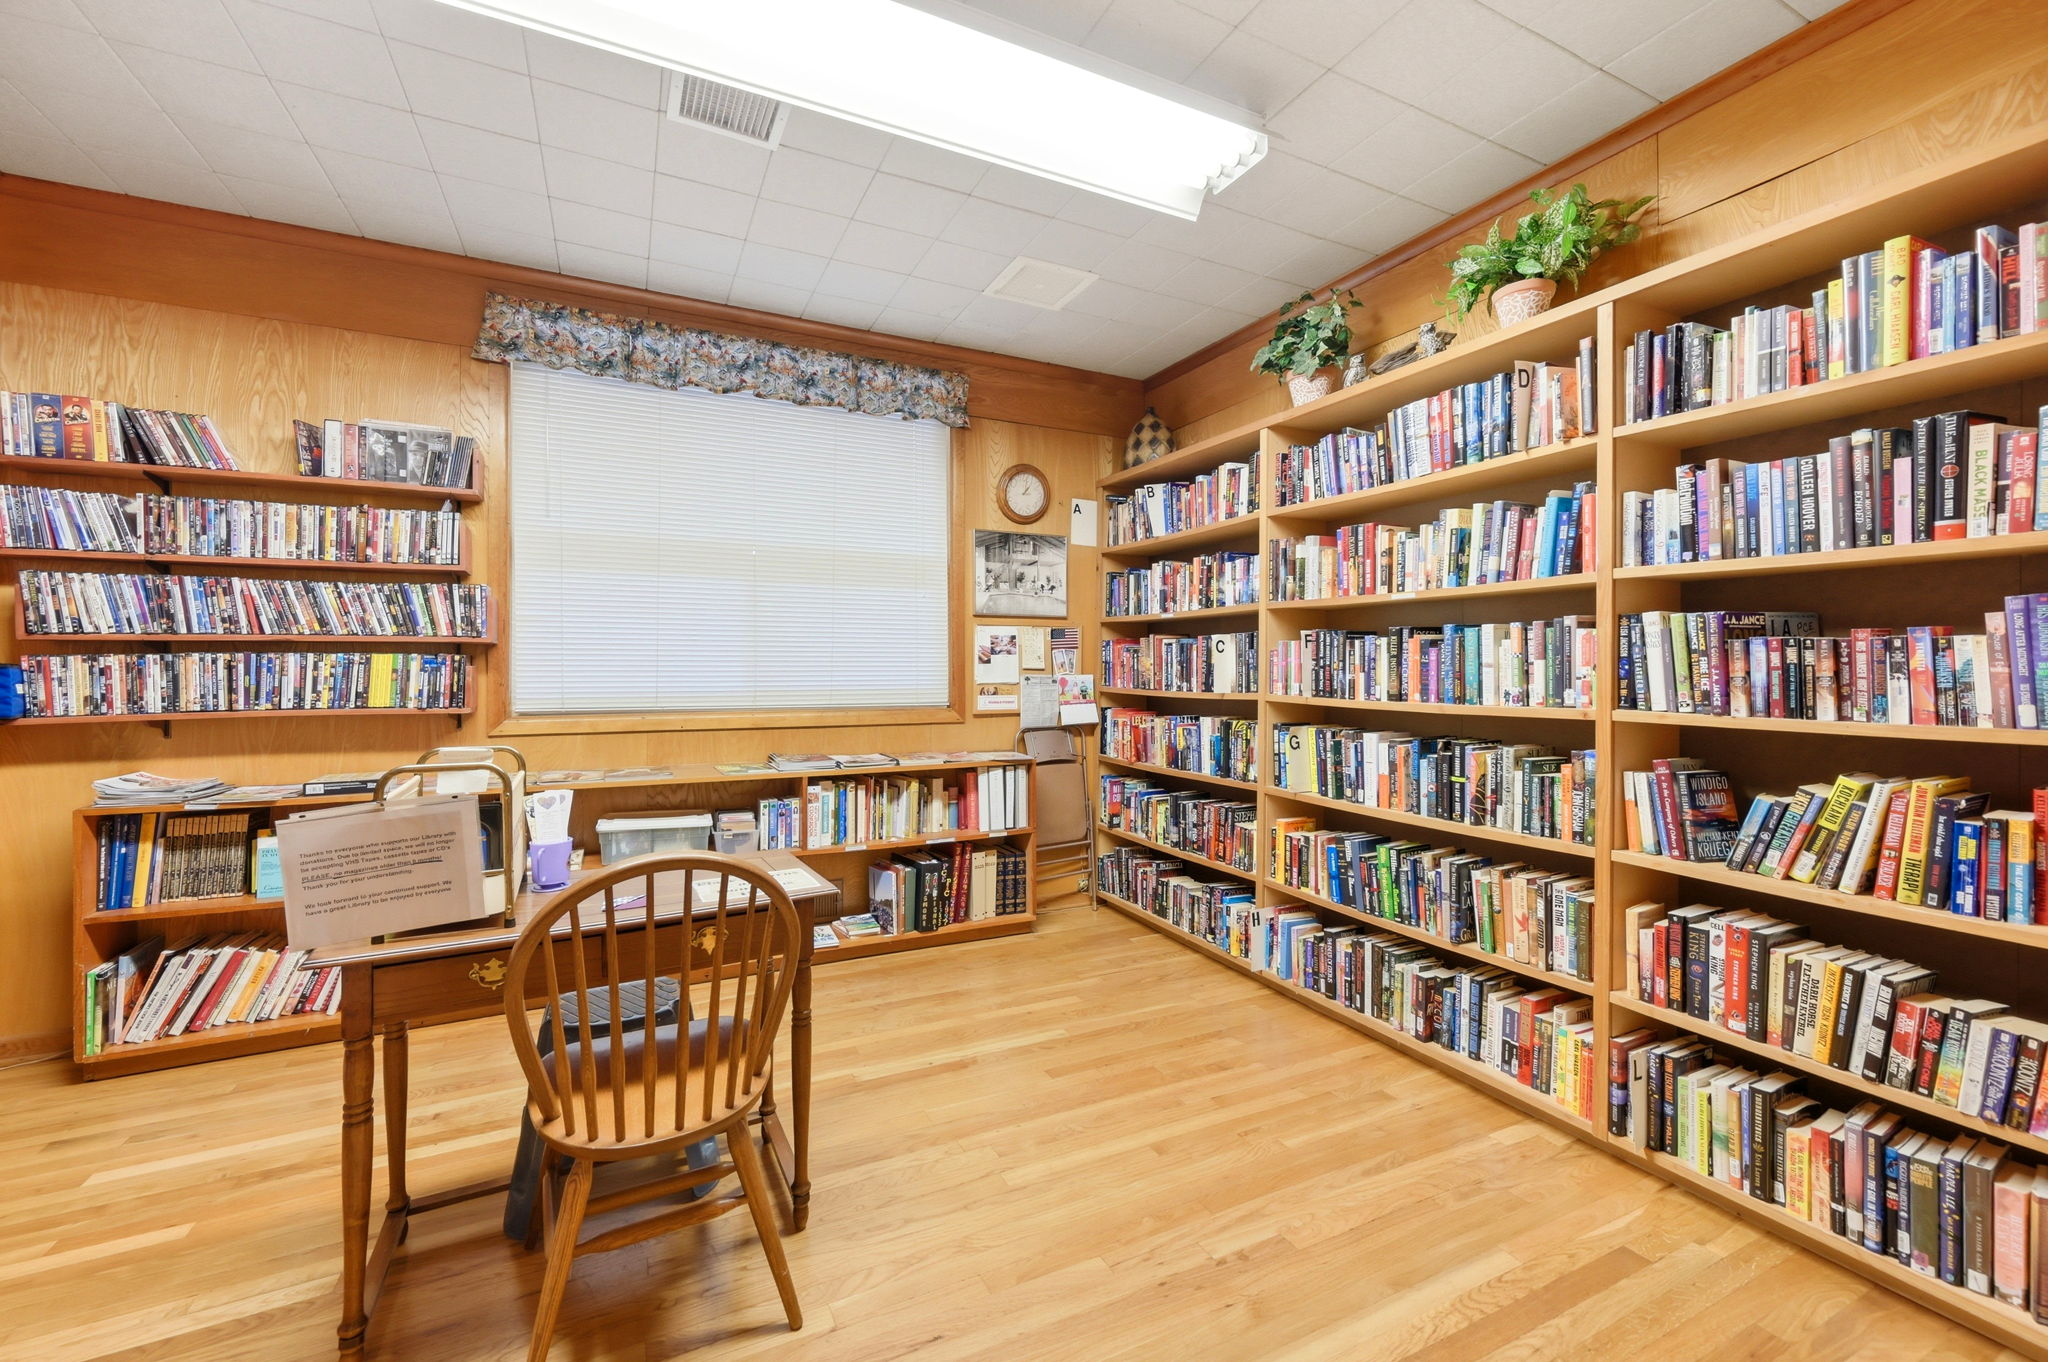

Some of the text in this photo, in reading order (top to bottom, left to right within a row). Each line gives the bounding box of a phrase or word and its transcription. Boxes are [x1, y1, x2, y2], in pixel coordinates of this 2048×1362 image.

[2003, 256, 2020, 284] HILL
[1890, 290, 1902, 350] CARL HIAASEN
[1518, 368, 1530, 388] D
[1944, 415, 1957, 464] TIME HUNT
[1974, 450, 1988, 485] BLACK
[2024, 451, 2034, 478] LOSING
[1148, 486, 1155, 498] B
[1679, 477, 1694, 526] Retribution
[1801, 458, 1814, 530] COLLEEN HOOVER
[1074, 504, 1082, 514] A
[1855, 490, 1863, 524] ECHOED
[1724, 613, 1766, 624] J.A. JANCE
[1216, 640, 1225, 654] C
[1305, 634, 1312, 648] F
[1620, 626, 1630, 657] LISA JACKSON
[1698, 630, 1706, 650] JANCE
[2014, 613, 2028, 676] LONG AFTER MIDNIGHT
[1700, 656, 1710, 690] FIRE ICE
[1712, 668, 1720, 682] J.A.
[1936, 656, 1952, 688] JOHANSEN
[1290, 735, 1300, 750] G
[1572, 790, 1584, 806] JOHN
[1663, 788, 1671, 797] the
[1690, 776, 1728, 806] WINDIGO ISLAND
[1664, 797, 1674, 823] Company
[1825, 784, 1854, 826] KOCHLAND
[1848, 809, 1862, 830] TAYLOR
[1670, 830, 1678, 848] Others
[1696, 832, 1720, 843] WILLIAM
[1878, 798, 1907, 887] FAYE KELLERMAN STALKER
[1902, 785, 1928, 894] JONATHAN KELLERMAN THERAPY
[311, 862, 344, 872] accepting
[344, 866, 378, 874] magazines
[306, 908, 322, 916] have
[330, 904, 346, 912] great
[348, 900, 370, 908] Library
[390, 892, 414, 901] enjoyed
[334, 896, 358, 904] forward
[384, 886, 414, 895] continued
[1986, 894, 2000, 920] MYSTERY
[1252, 912, 1260, 927] H
[1554, 894, 1564, 927] ONE MAN
[1710, 922, 1725, 931] CELL
[1690, 932, 1698, 960] KING
[1750, 940, 1758, 971] STEPHEN
[1710, 956, 1718, 974] KING
[1796, 963, 1812, 1036] FLETCHER KNEBEL
[1807, 978, 1820, 1028] DARK HORSE
[1820, 968, 1836, 1047] INTENSITY DEAN KOONTZ
[1948, 1018, 1964, 1068] DEAN KOONTZ
[1634, 1060, 1642, 1081] L
[1988, 1044, 2010, 1090] KOONTZ
[2014, 1055, 2038, 1096] KOONTZ
[1666, 1124, 1674, 1144] FALL
[1946, 1162, 1956, 1210] HARPER LEE
